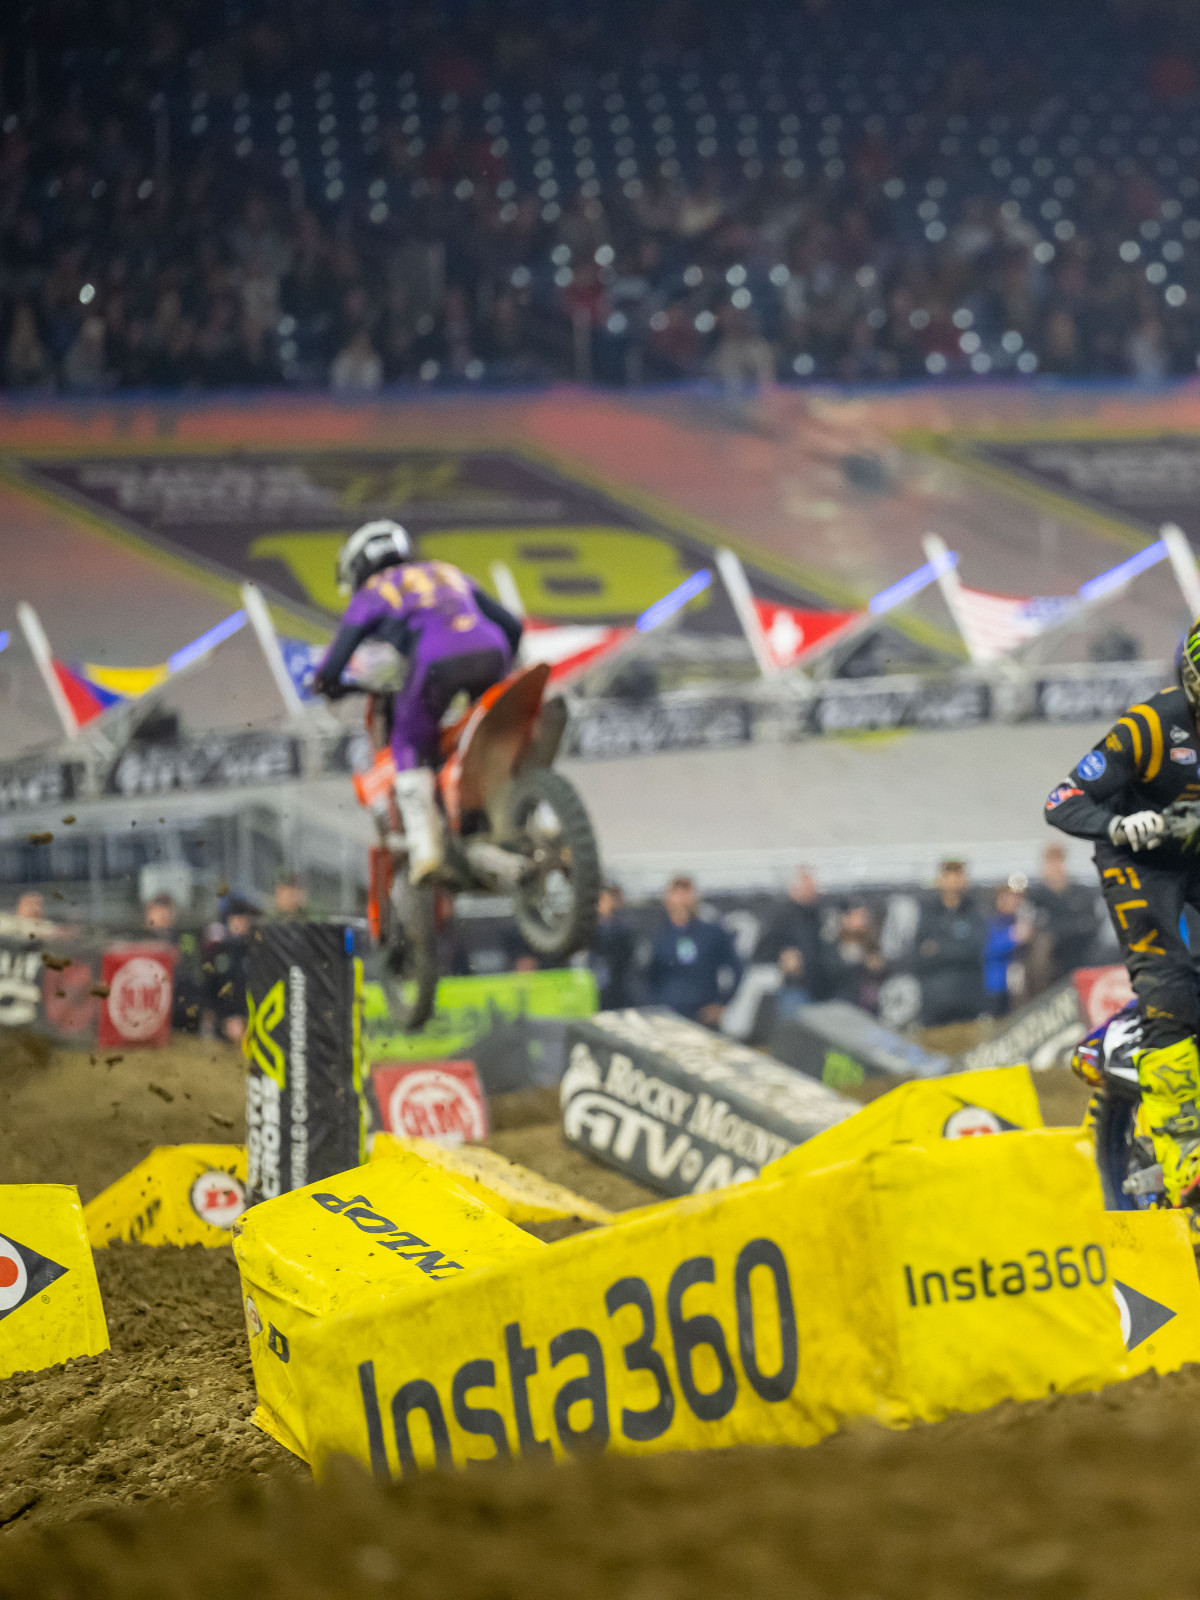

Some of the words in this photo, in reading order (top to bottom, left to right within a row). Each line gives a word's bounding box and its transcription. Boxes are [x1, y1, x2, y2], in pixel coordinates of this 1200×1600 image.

[604, 1052, 694, 1126] ROCKY
[311, 1192, 465, 1281] NLOP
[904, 1243, 1107, 1307] Insta360
[357, 1237, 799, 1482] Insta360
